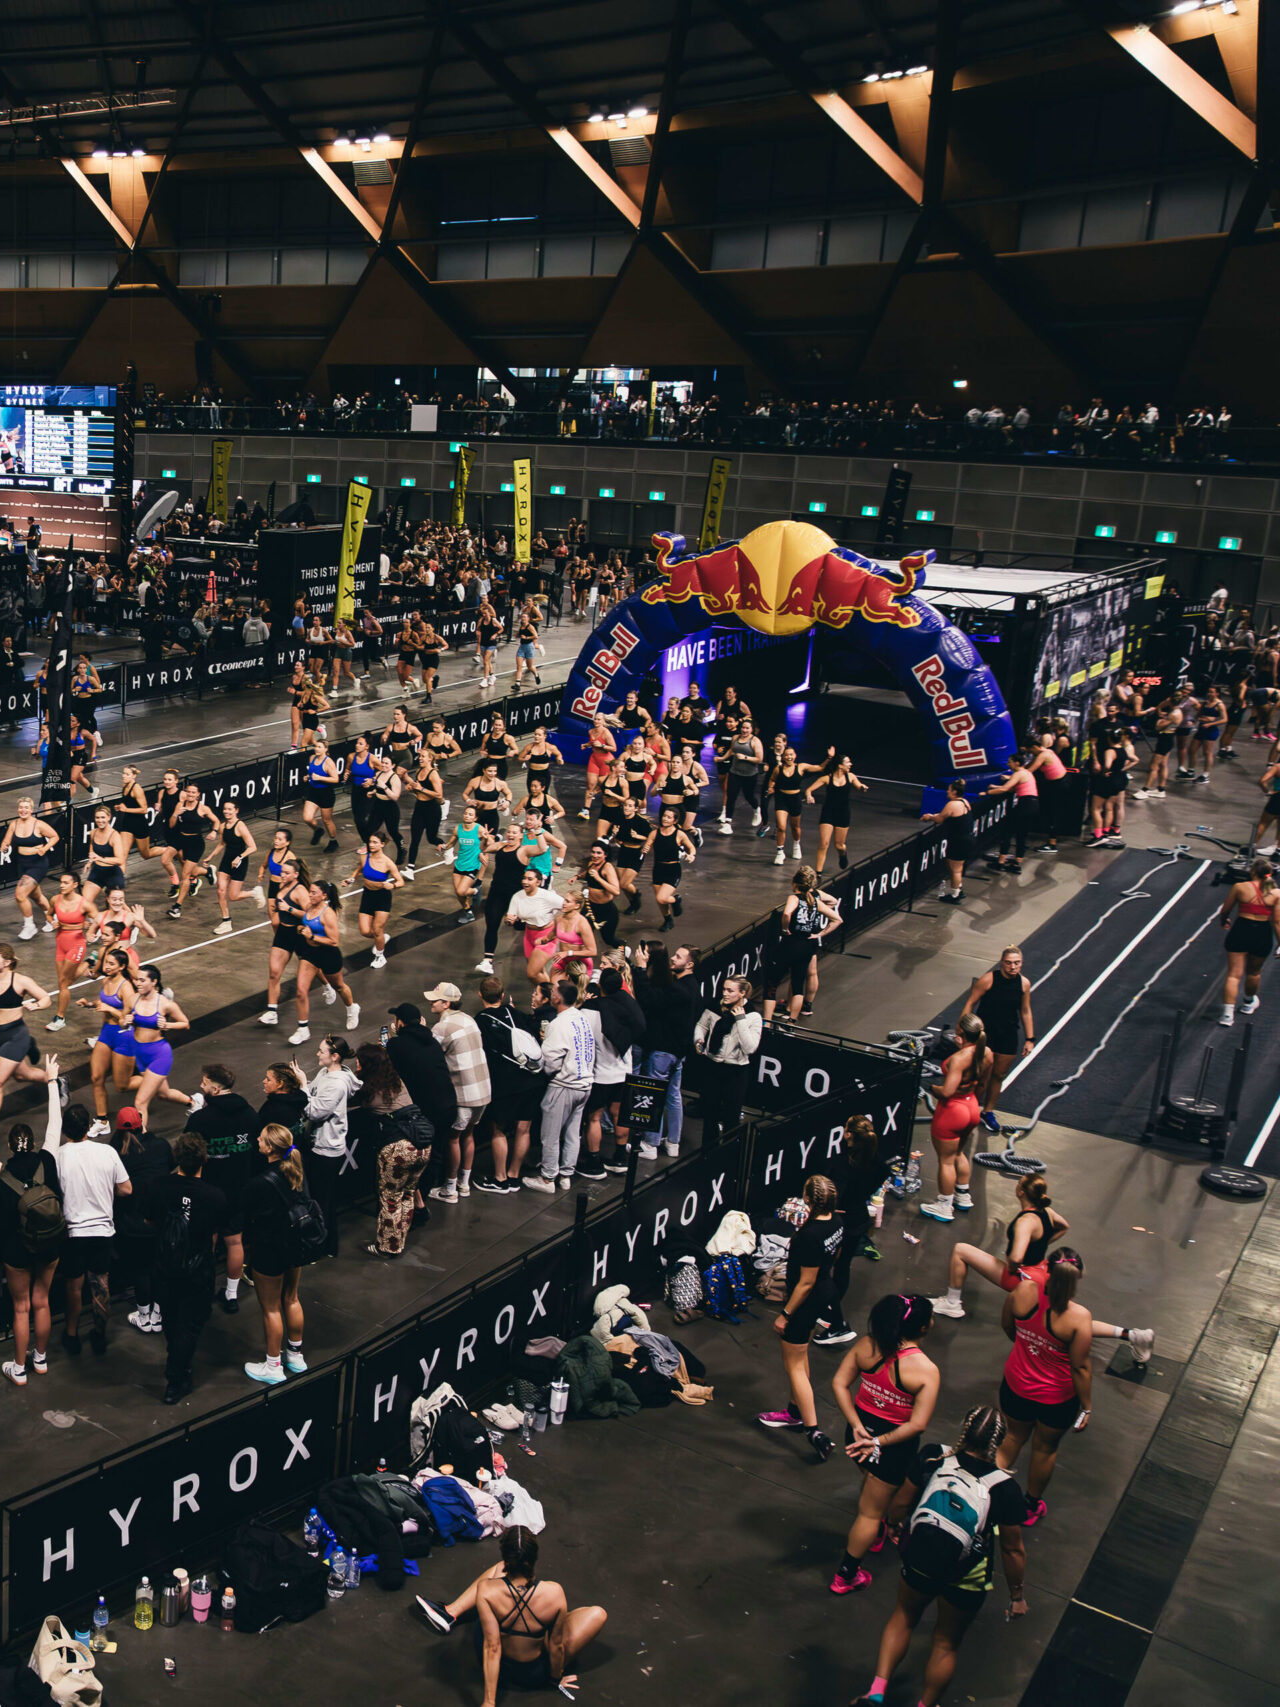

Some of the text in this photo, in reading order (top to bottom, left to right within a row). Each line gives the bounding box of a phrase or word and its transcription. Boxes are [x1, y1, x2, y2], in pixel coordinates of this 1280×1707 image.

[6, 386, 44, 395] HYROX
[519, 466, 527, 542] HYROX
[707, 464, 725, 536] HYROX
[301, 562, 375, 580] THIS IS TH OMENT
[309, 580, 366, 597] YOU HA EEN
[222, 657, 264, 672] concept 2
[277, 649, 312, 665] HYR
[570, 622, 640, 720] Red Bull
[667, 640, 706, 672] HAVE
[709, 634, 742, 661] BEEN
[132, 667, 193, 690] HYROX
[510, 700, 561, 726] HYROX
[911, 653, 988, 770] Red Bull
[44, 781, 71, 790] MPETING
[972, 799, 1008, 837] HYROX
[920, 839, 948, 873] HYR
[854, 859, 910, 910] HYROX
[765, 1101, 901, 1186] HYRX
[592, 1171, 725, 1286] HYROX
[372, 1280, 551, 1423] HYROX
[41, 1418, 314, 1583] HYROX
